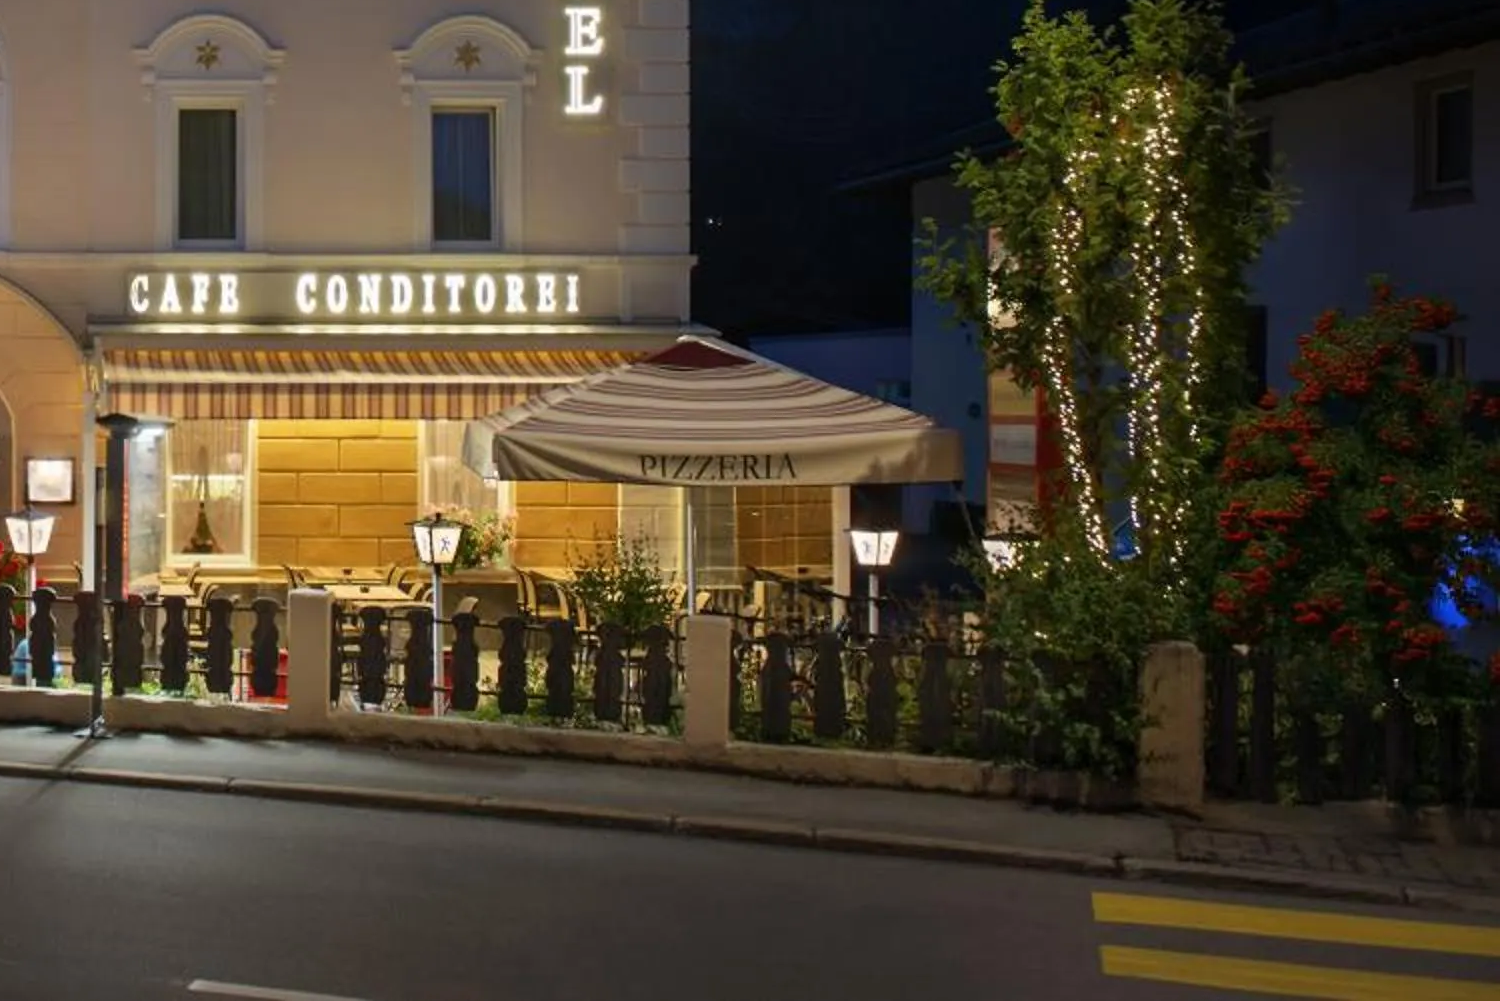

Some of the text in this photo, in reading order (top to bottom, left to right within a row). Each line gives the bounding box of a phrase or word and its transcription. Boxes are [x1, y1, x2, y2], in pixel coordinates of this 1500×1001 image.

[130, 273, 579, 314] CAFE CONDITOREI
[639, 453, 797, 481] PIZZERIA
